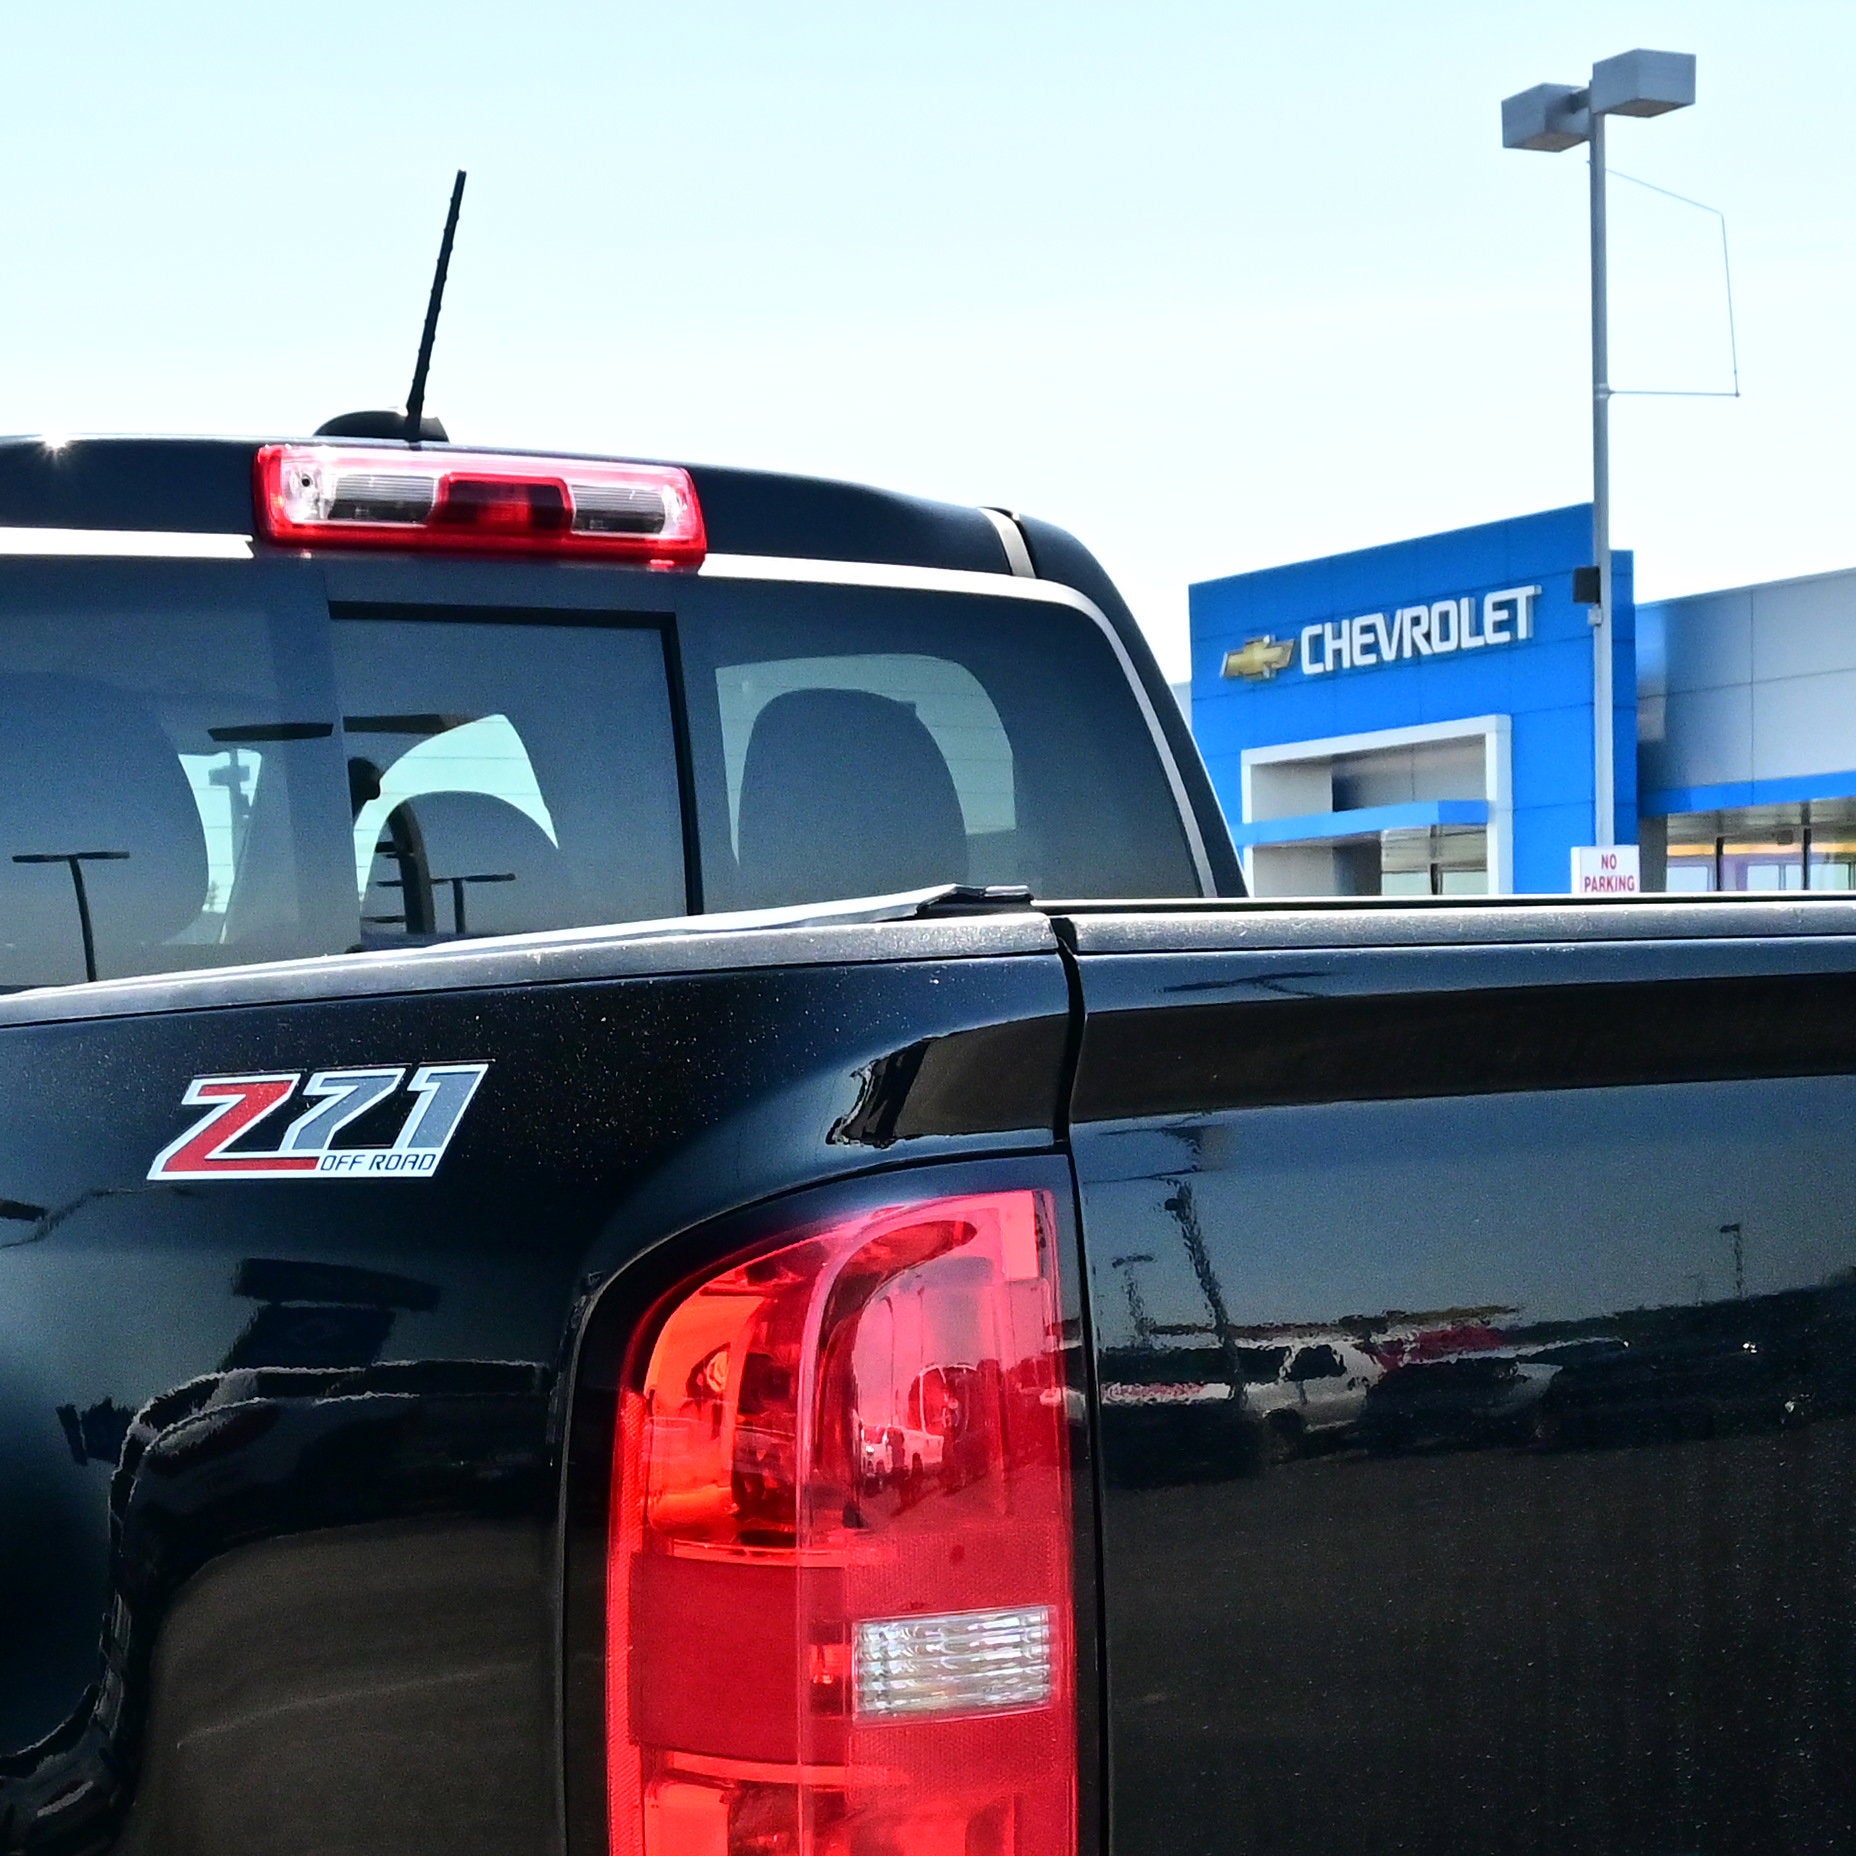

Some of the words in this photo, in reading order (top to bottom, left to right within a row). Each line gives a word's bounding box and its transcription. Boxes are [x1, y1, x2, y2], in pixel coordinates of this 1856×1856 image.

[1301, 585, 1542, 675] CHEVROLET
[1601, 853, 1618, 870] NO
[1584, 875, 1636, 893] PARKING
[146, 1063, 490, 1180] Z71
[320, 1154, 366, 1171] OFF
[369, 1153, 437, 1171] ROAD
